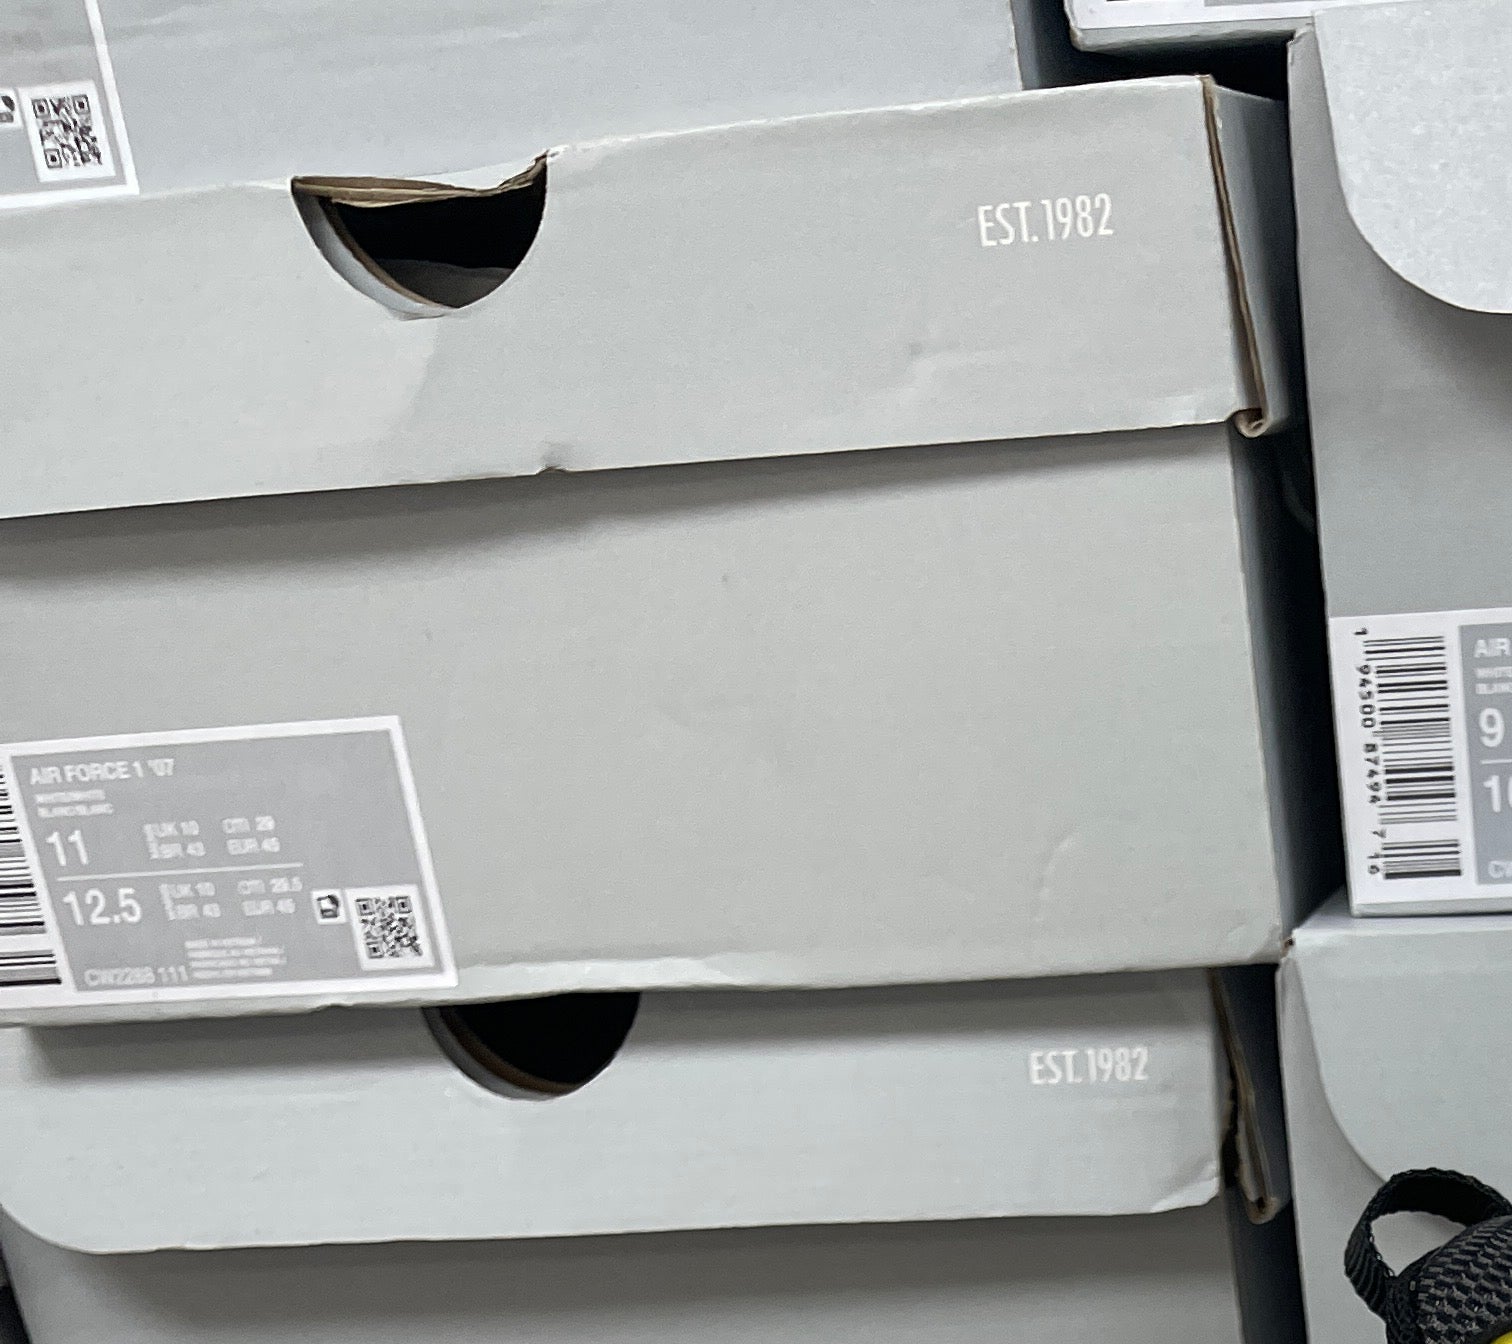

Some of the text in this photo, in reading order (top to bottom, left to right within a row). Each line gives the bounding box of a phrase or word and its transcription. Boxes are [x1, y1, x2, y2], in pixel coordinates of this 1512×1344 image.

[1041, 194, 1114, 242] 1982
[1473, 637, 1511, 658] AIR
[1478, 707, 1506, 748] 9
[65, 760, 130, 783] FORCE
[133, 761, 142, 779] 1
[45, 829, 90, 867] 11
[62, 887, 142, 926] 12.5
[1087, 1046, 1150, 1084] 1982
